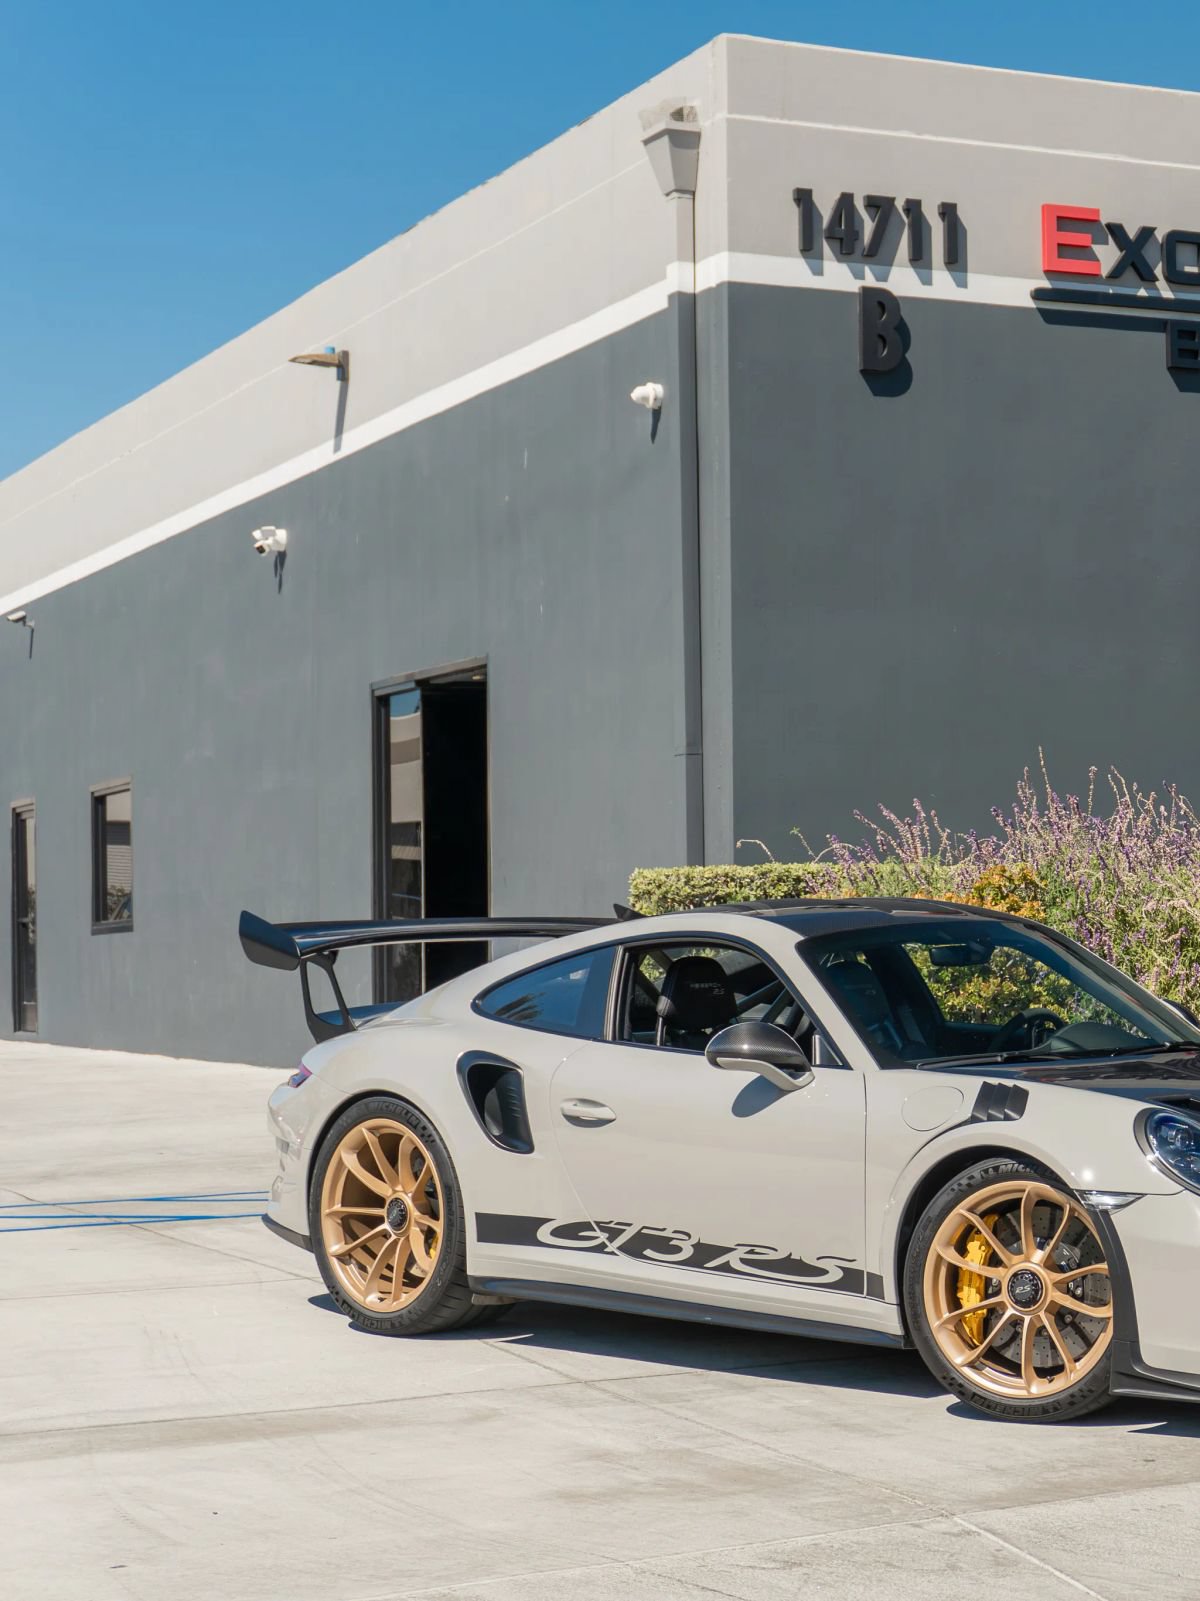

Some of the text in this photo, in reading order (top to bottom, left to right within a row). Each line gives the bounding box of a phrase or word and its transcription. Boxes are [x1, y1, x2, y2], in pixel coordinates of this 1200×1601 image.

[793, 187, 958, 265] 14711
[858, 285, 902, 373] B
[536, 1218, 857, 1284] GT3 RS
